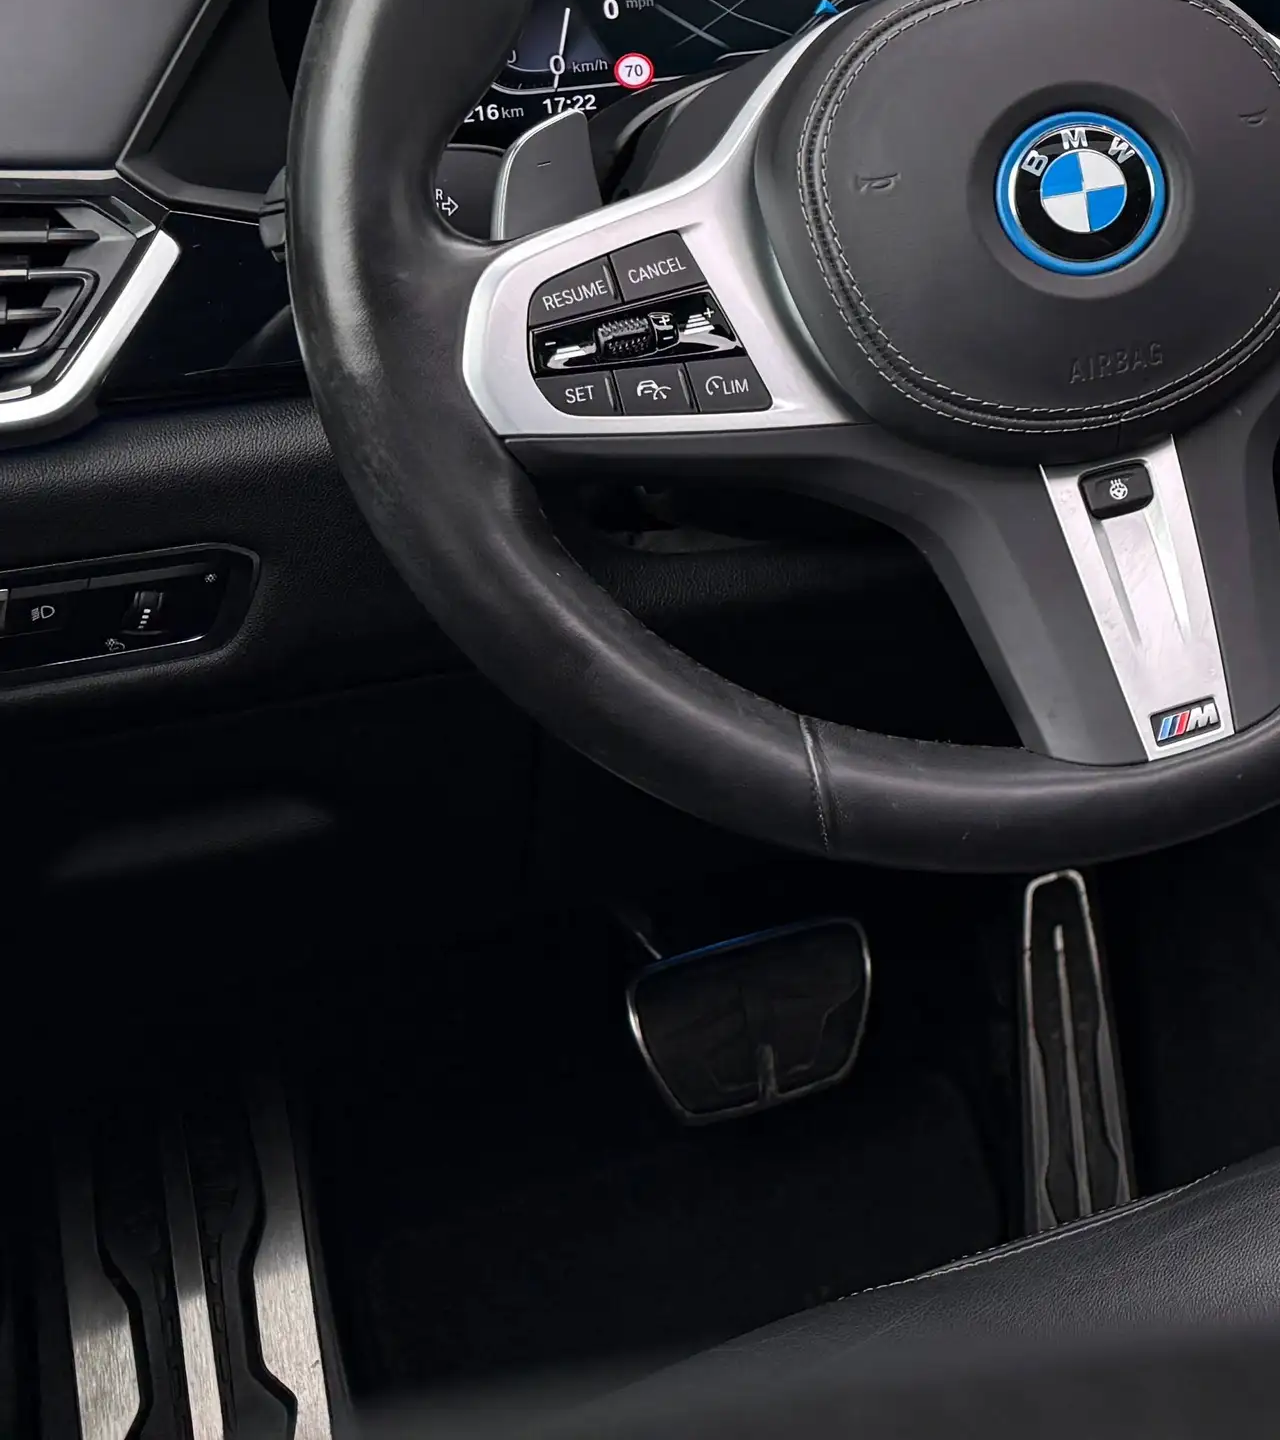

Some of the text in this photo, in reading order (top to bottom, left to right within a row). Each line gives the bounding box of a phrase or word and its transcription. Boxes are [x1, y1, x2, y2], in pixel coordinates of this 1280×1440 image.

[549, 54, 608, 75] 0 km/h
[624, 64, 643, 78] 70
[501, 107, 524, 119] km
[542, 94, 597, 114] 17:22
[1021, 127, 1136, 177] BMW
[435, 188, 443, 200] R
[628, 256, 687, 284] CANCEL
[542, 280, 608, 310] RESUME
[1070, 343, 1163, 384] AIRBAG
[565, 385, 595, 404] SET
[723, 378, 749, 395] LIM
[1186, 702, 1219, 732] M
